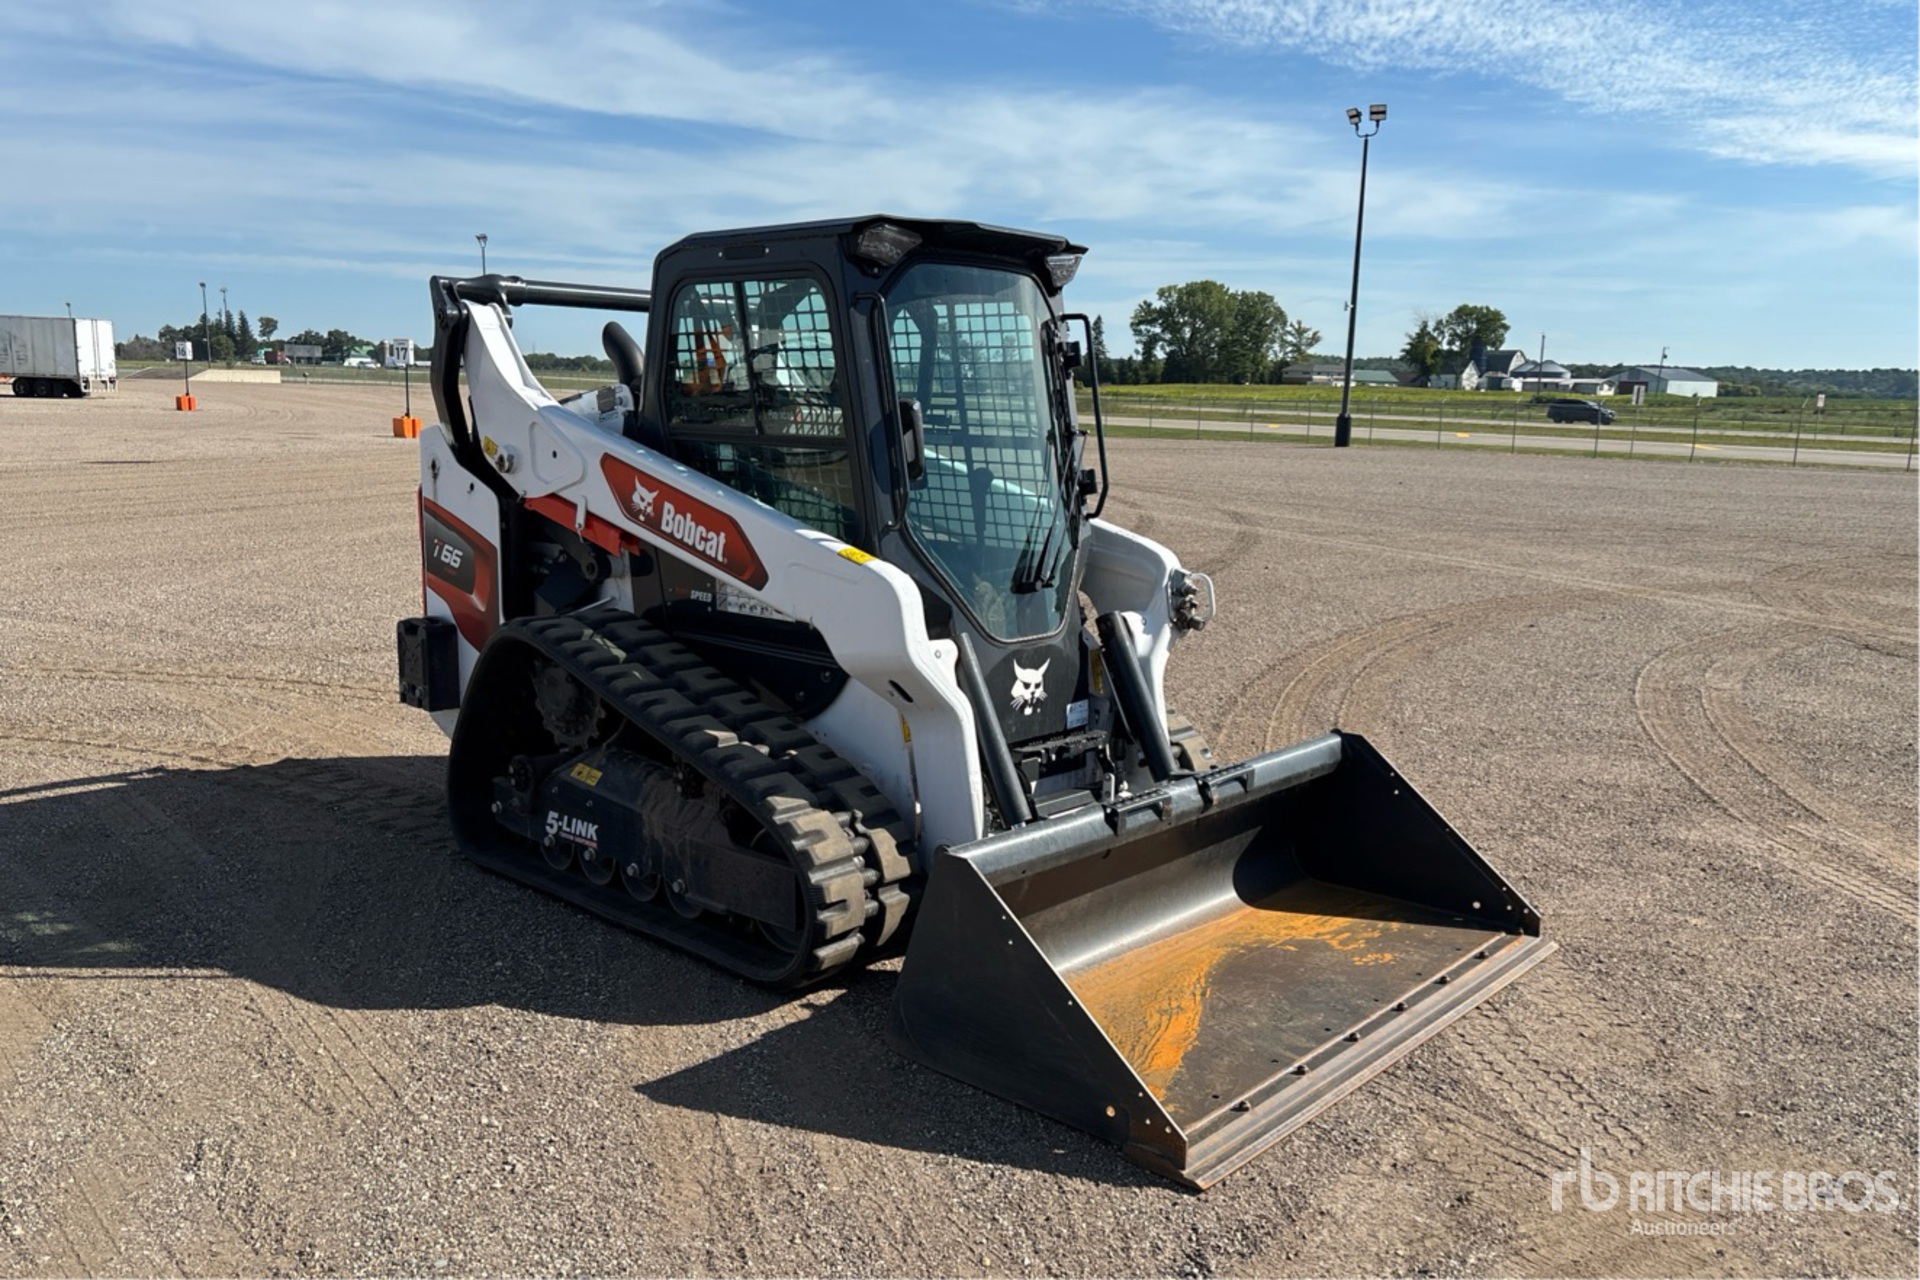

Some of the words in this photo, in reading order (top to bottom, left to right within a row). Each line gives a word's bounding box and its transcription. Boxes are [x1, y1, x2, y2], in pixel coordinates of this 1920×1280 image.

[395, 347, 409, 361] 17
[661, 500, 727, 563] Bobcat
[433, 538, 464, 569] T66
[689, 589, 713, 603] SPEED
[545, 810, 599, 841] 5-LINK
